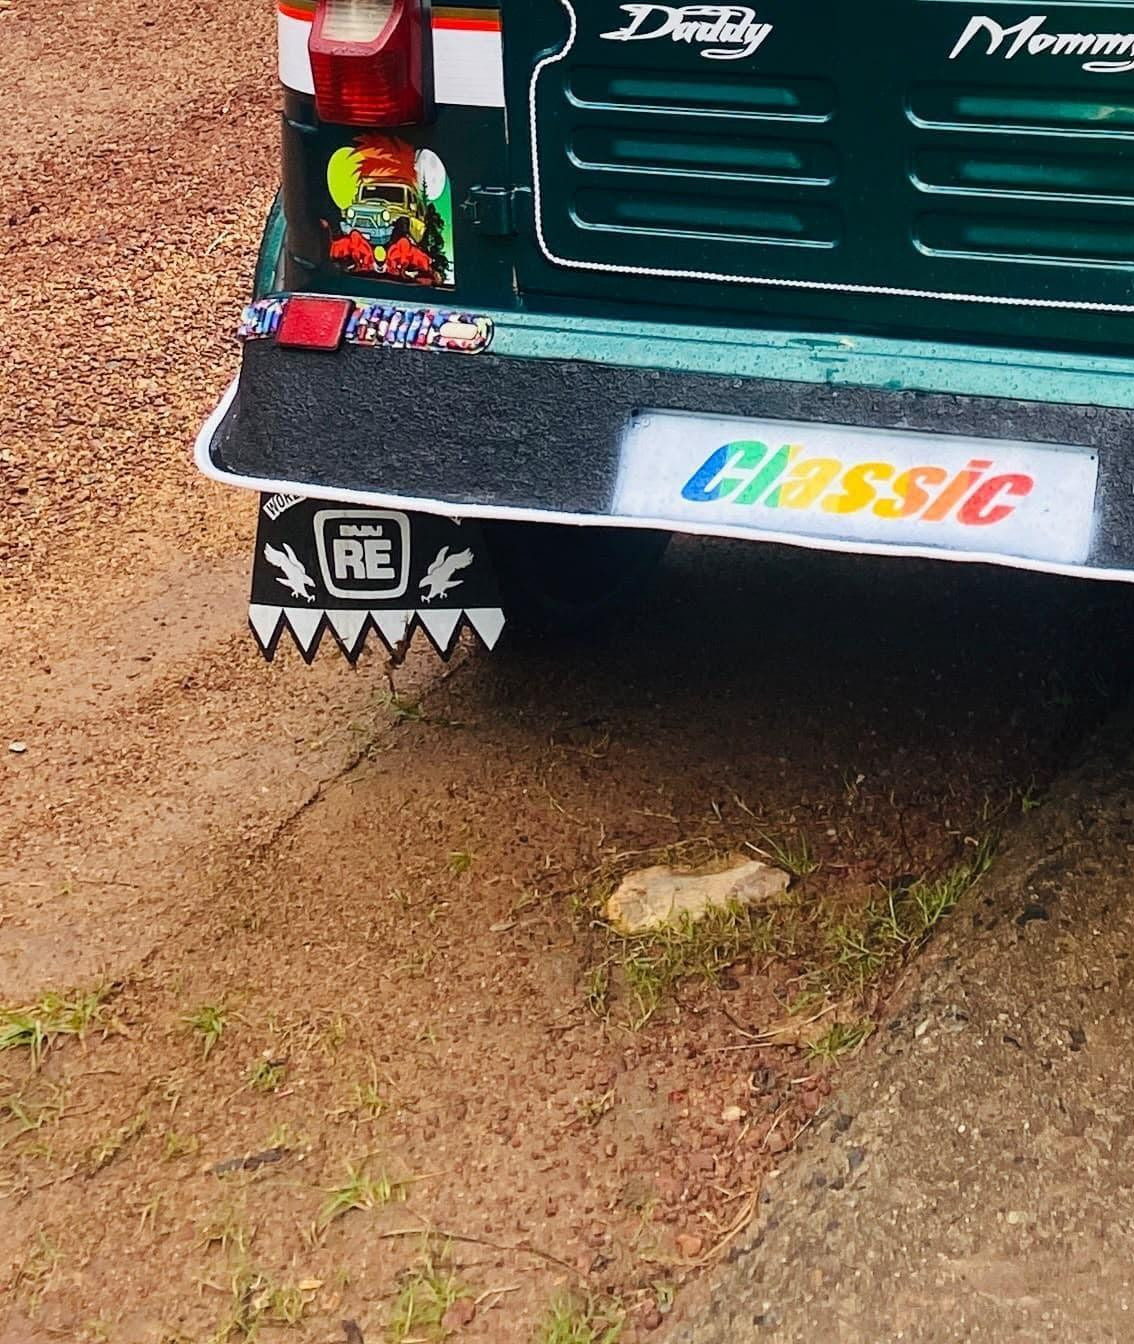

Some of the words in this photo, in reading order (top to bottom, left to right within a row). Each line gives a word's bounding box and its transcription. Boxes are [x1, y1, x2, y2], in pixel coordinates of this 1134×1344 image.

[600, 3, 773, 60] Daddy
[680, 440, 1035, 526] Classic
[333, 539, 396, 580] RE
